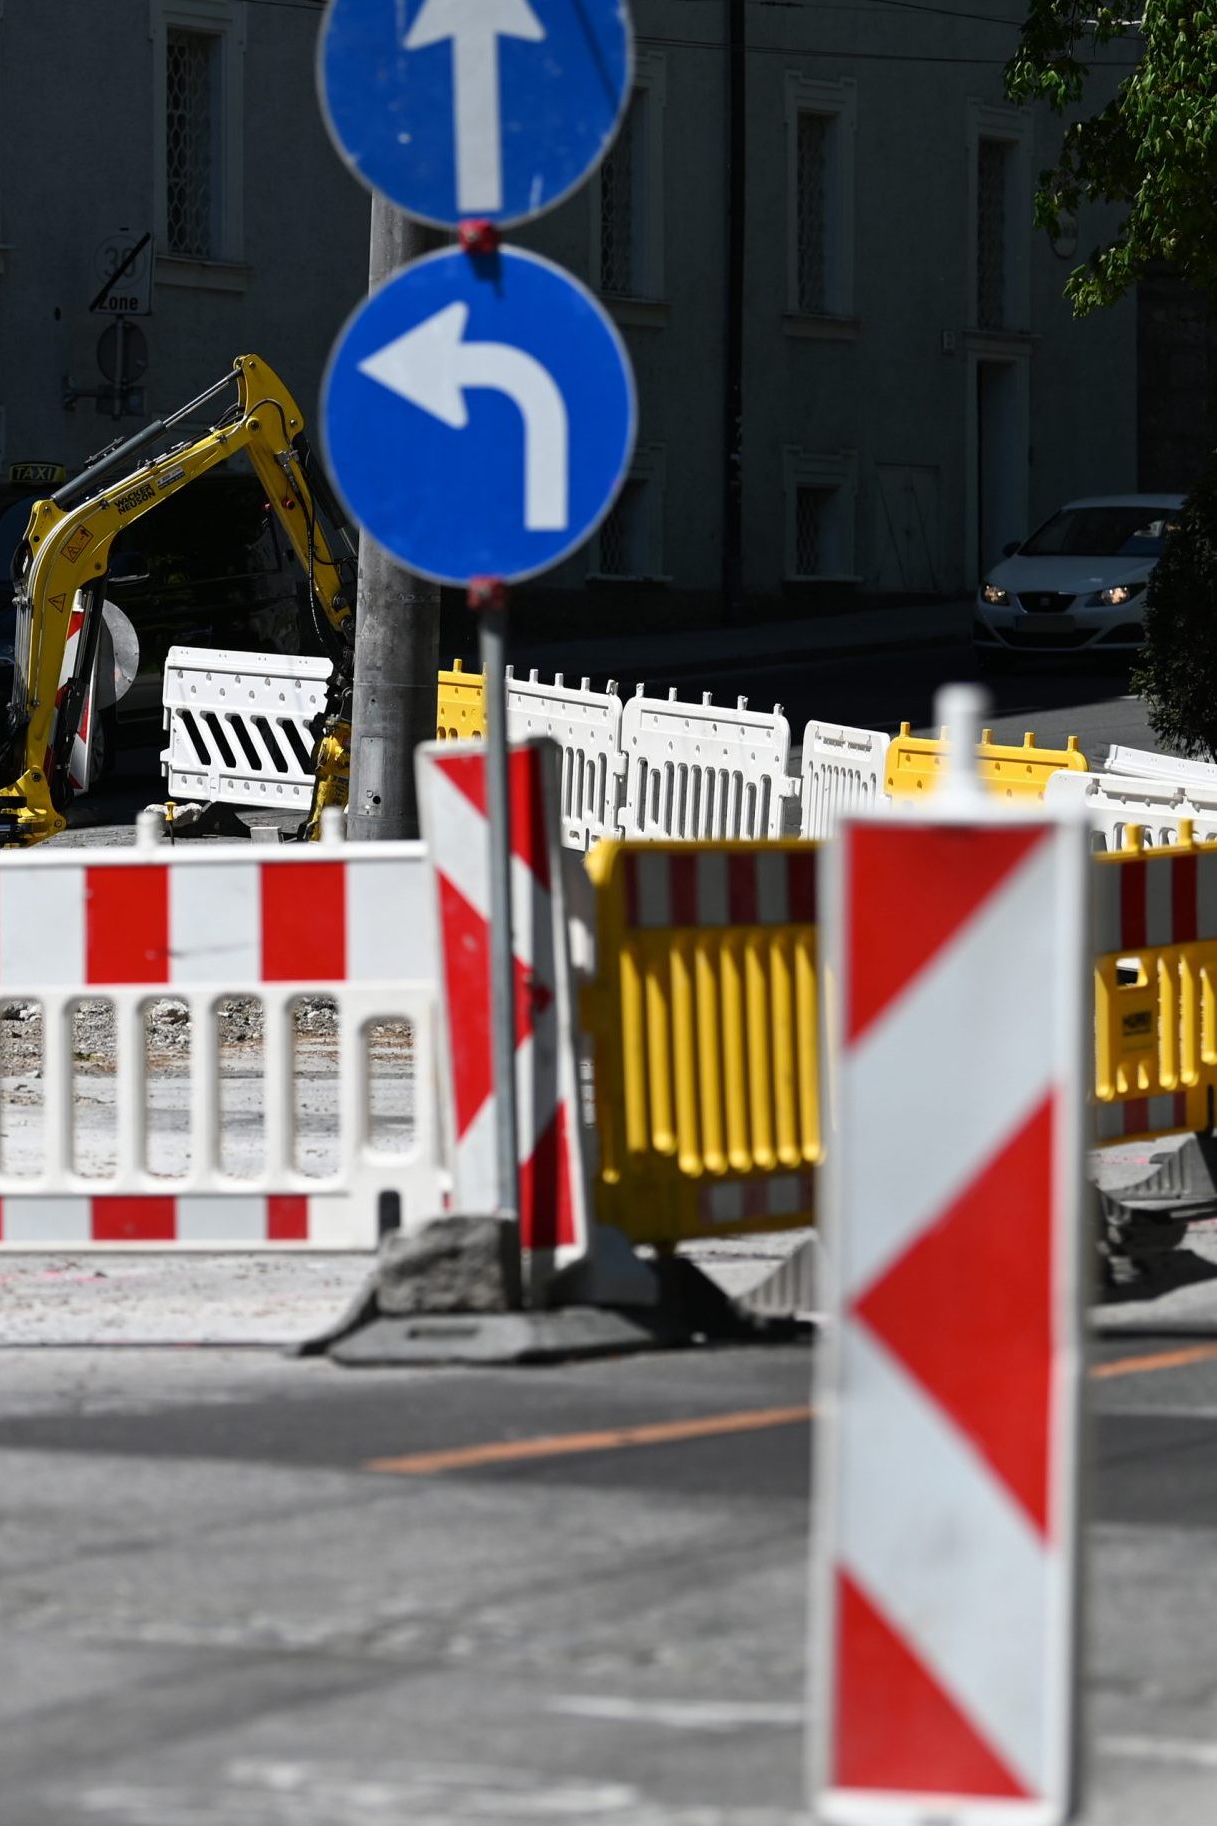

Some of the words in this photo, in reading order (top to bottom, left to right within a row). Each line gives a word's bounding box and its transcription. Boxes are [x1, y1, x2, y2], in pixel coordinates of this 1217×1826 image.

[104, 246, 136, 278] 30
[13, 466, 55, 480] TAXI
[113, 483, 152, 508] WACKER
[117, 488, 156, 515] NEUSON
